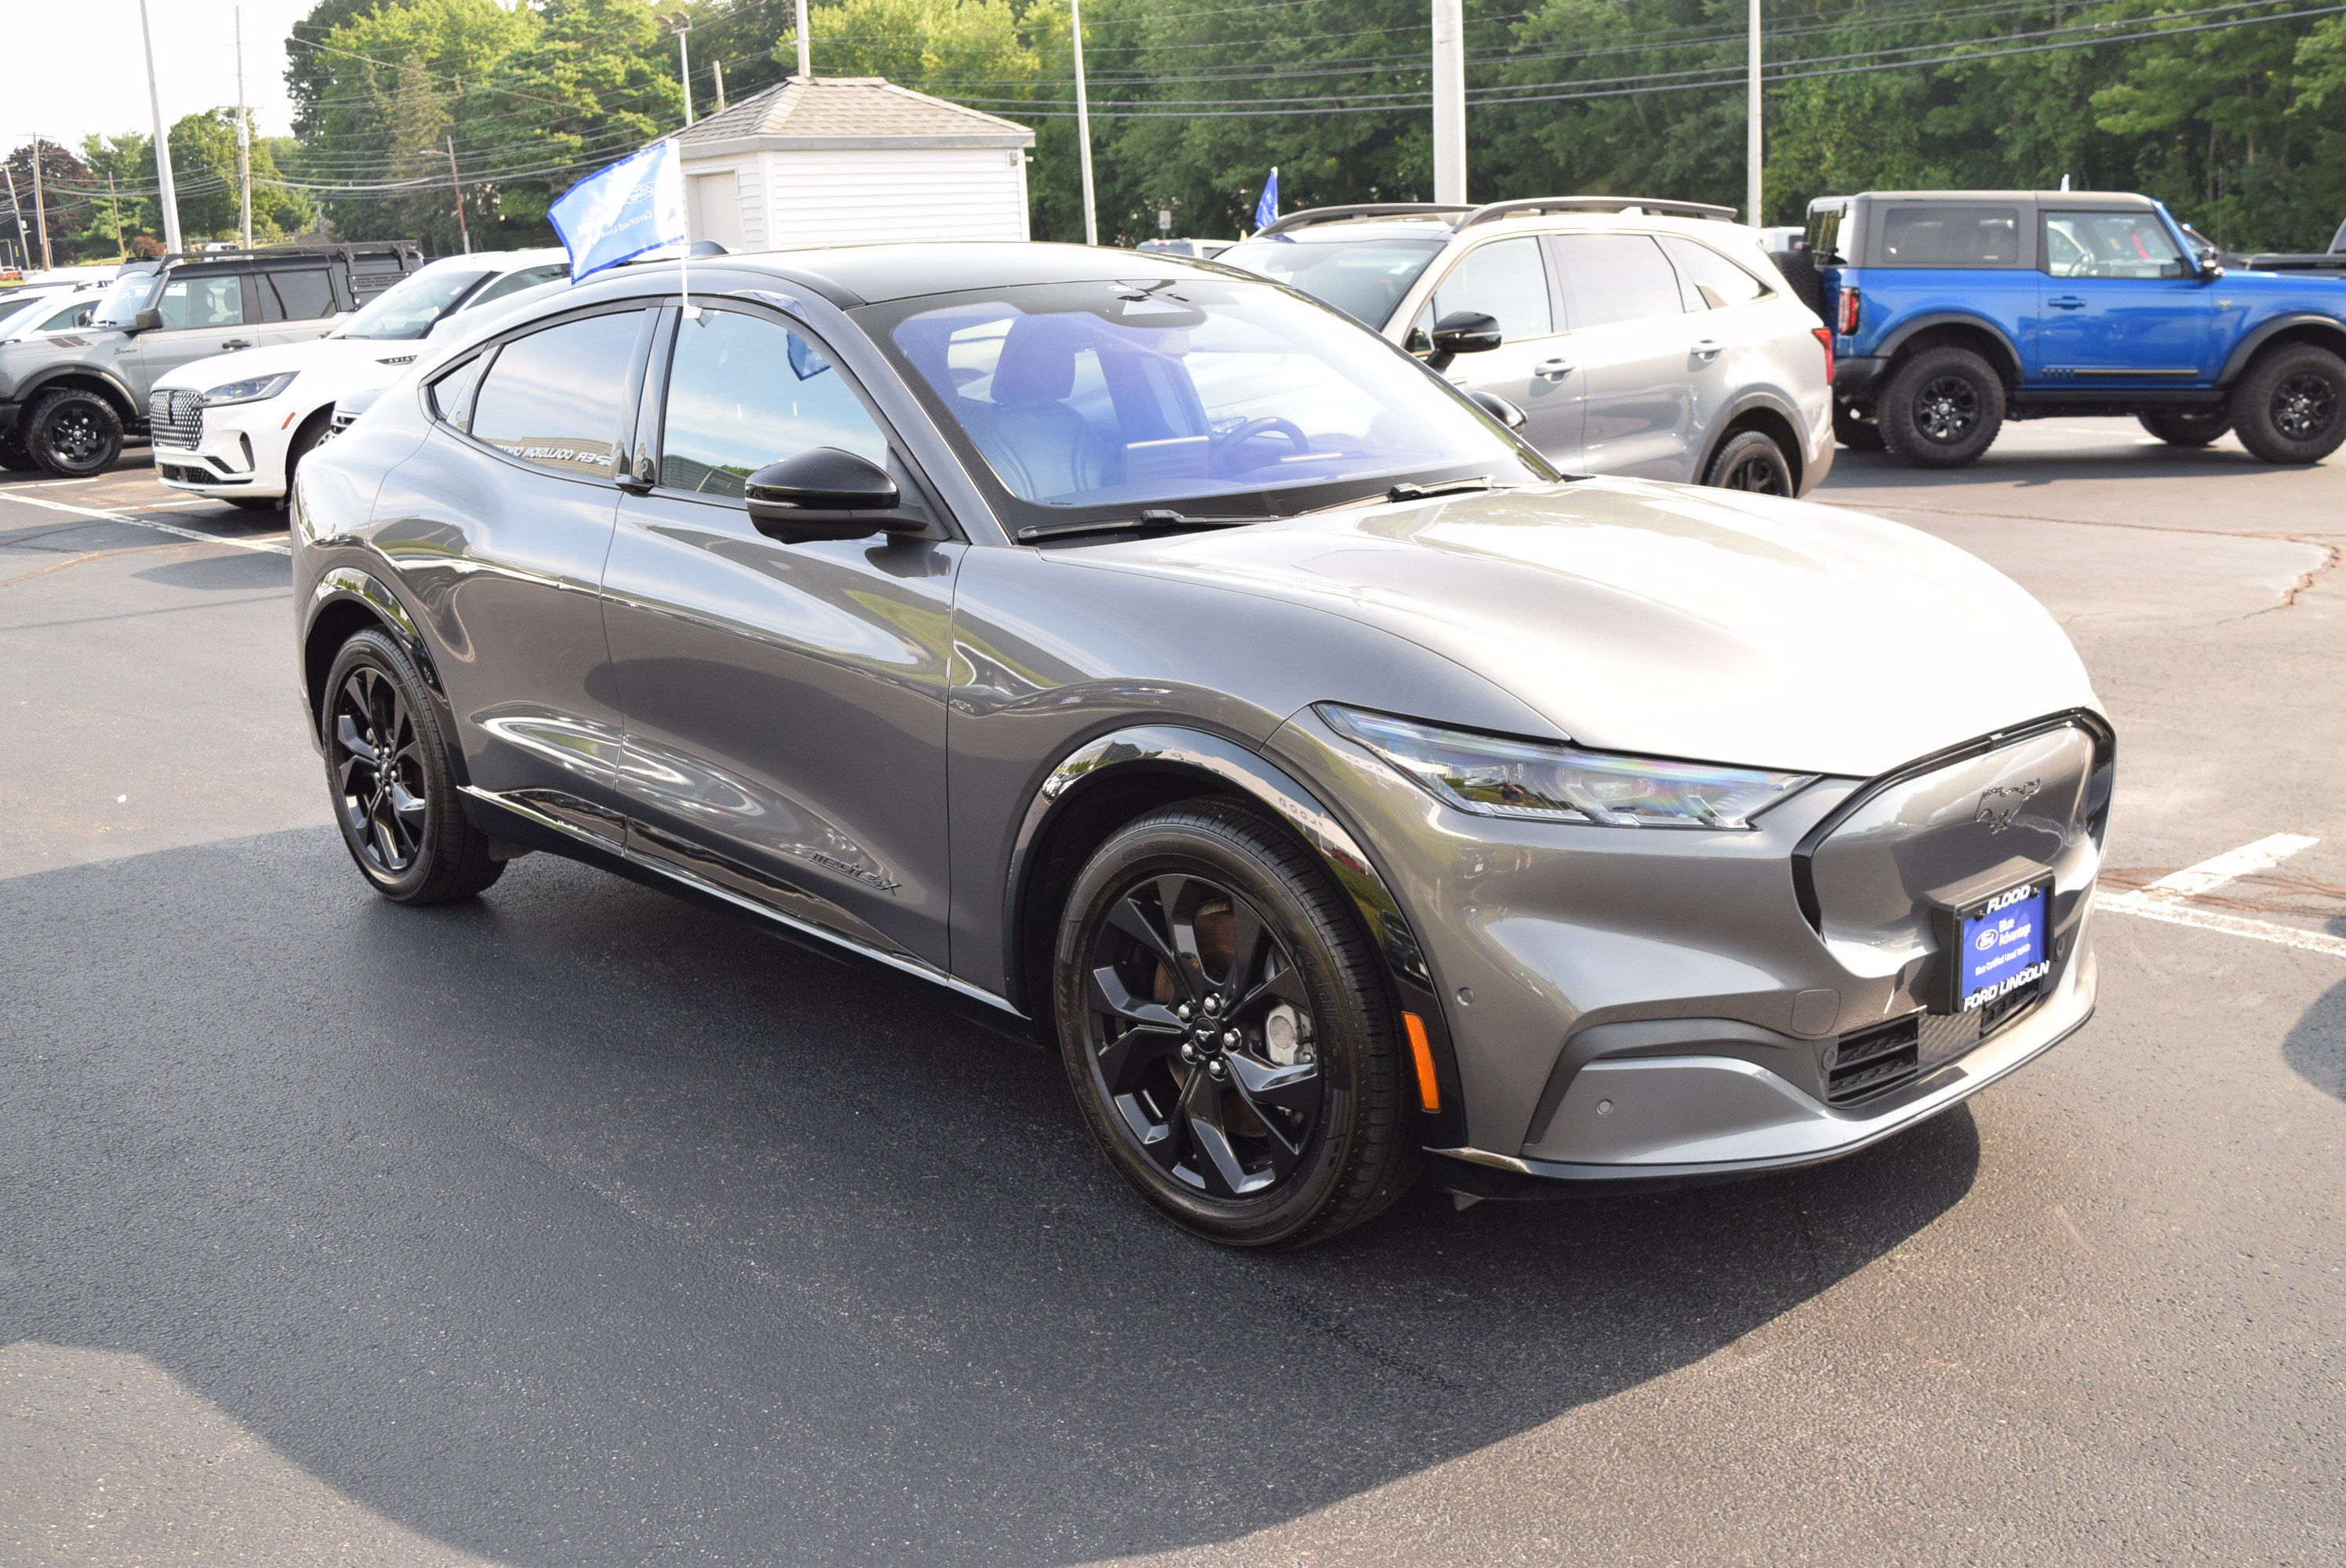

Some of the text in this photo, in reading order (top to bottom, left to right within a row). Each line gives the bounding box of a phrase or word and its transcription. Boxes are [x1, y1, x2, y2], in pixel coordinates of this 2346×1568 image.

[1986, 884, 2031, 914] FLOOD
[1999, 918, 2014, 933] Blue
[1999, 924, 2032, 946] Advantage
[1975, 942, 2031, 976] Blue Certified Used Vehicle
[1963, 960, 2050, 1012] FORD LINCOLN
